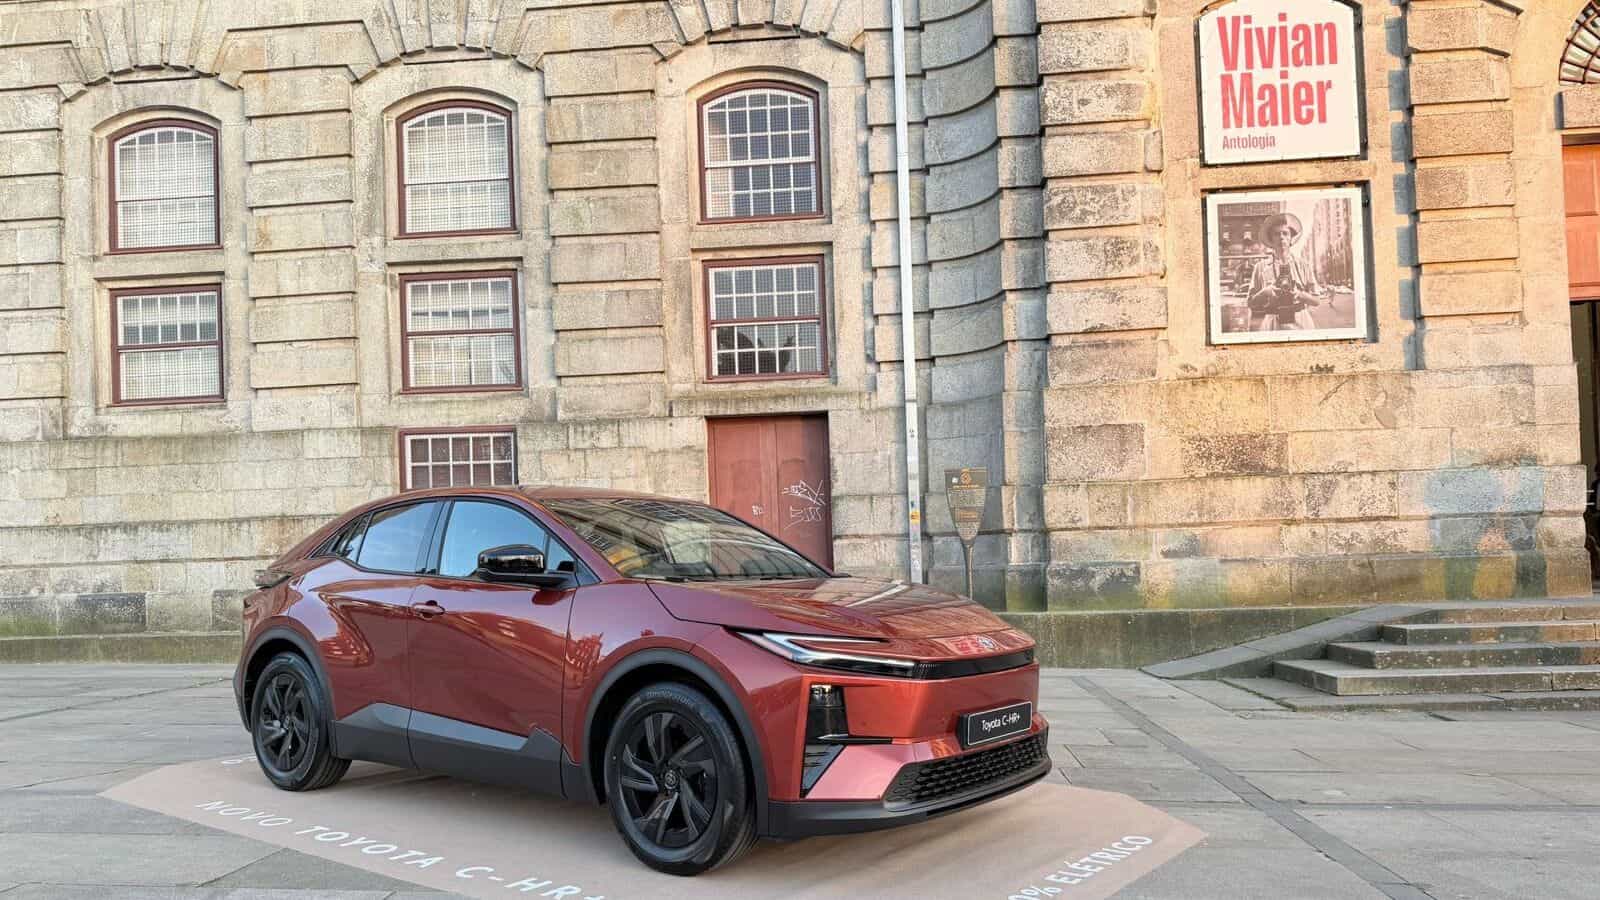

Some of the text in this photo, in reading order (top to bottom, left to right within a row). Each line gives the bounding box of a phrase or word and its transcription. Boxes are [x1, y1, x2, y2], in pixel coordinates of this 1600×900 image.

[1217, 12, 1338, 71] Vivian
[1220, 70, 1332, 129] Maier
[1222, 134, 1276, 150] Antologia
[982, 712, 1020, 733] Toyota C-HR+
[195, 801, 293, 826] NOVO
[295, 825, 445, 868] TOYOTA
[1045, 835, 1153, 885] ELÉTRICO
